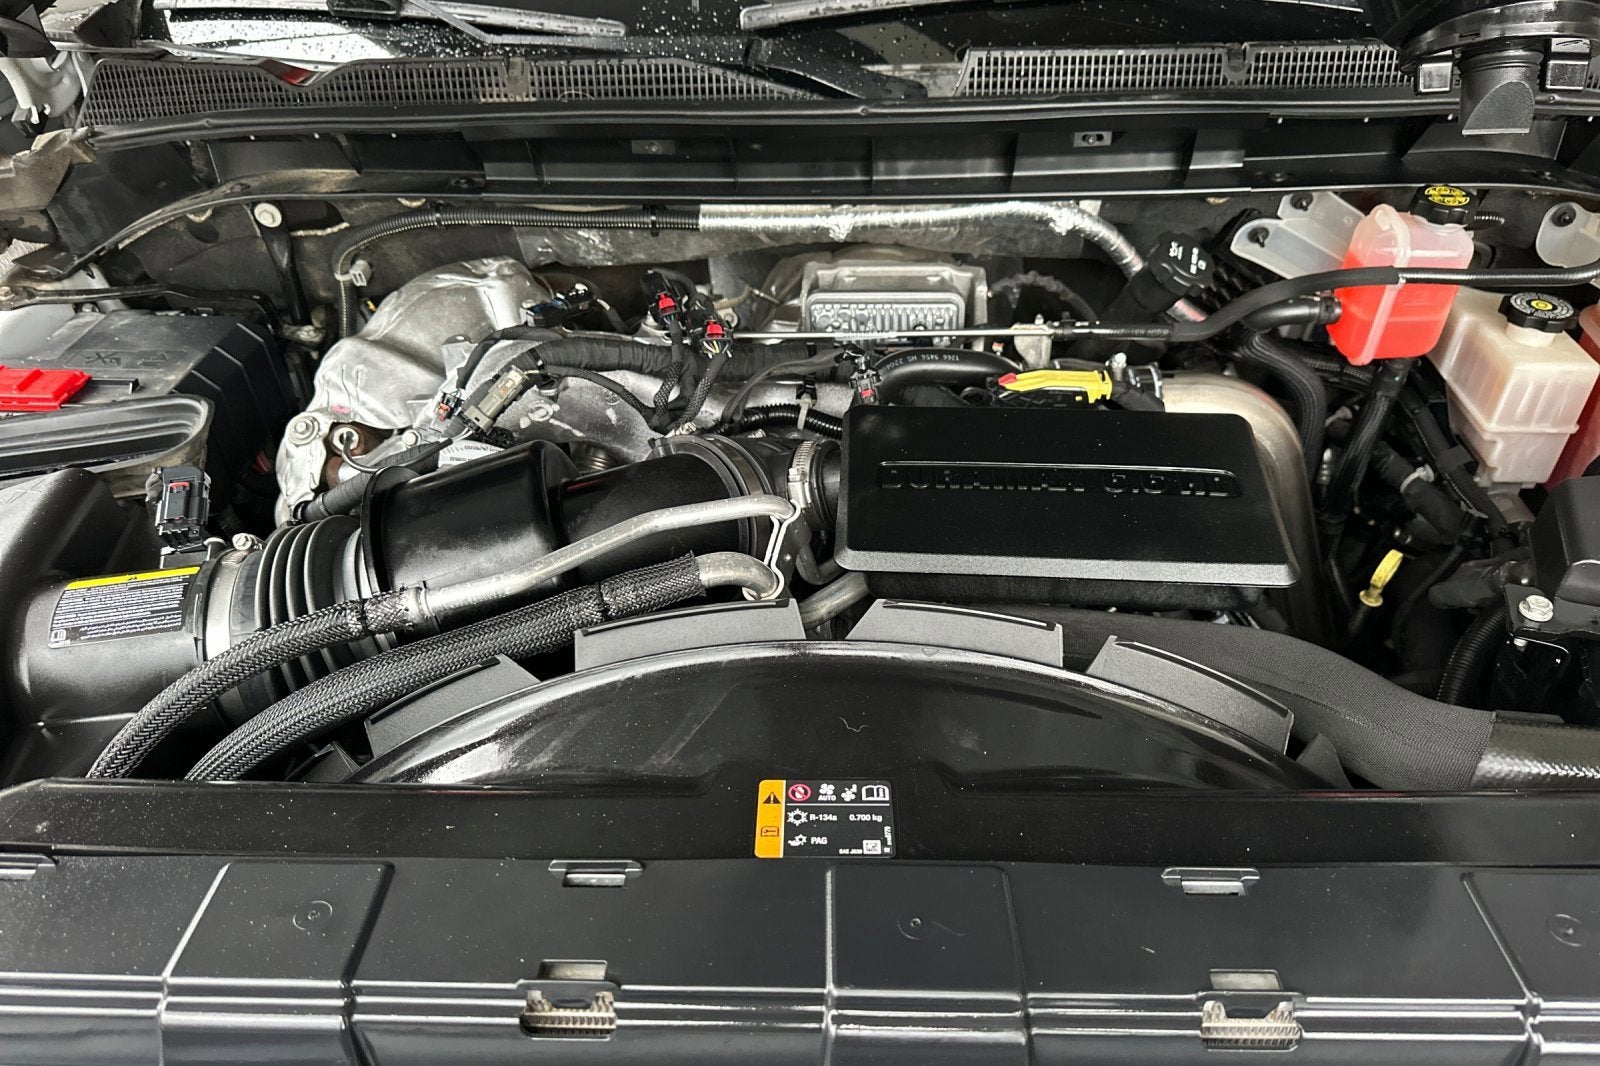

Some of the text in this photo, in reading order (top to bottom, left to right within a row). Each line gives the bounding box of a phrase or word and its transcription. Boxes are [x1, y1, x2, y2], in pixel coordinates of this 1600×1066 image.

[849, 814, 871, 822] 0.700
[872, 814, 883, 822] kg
[811, 837, 828, 845] PAG
